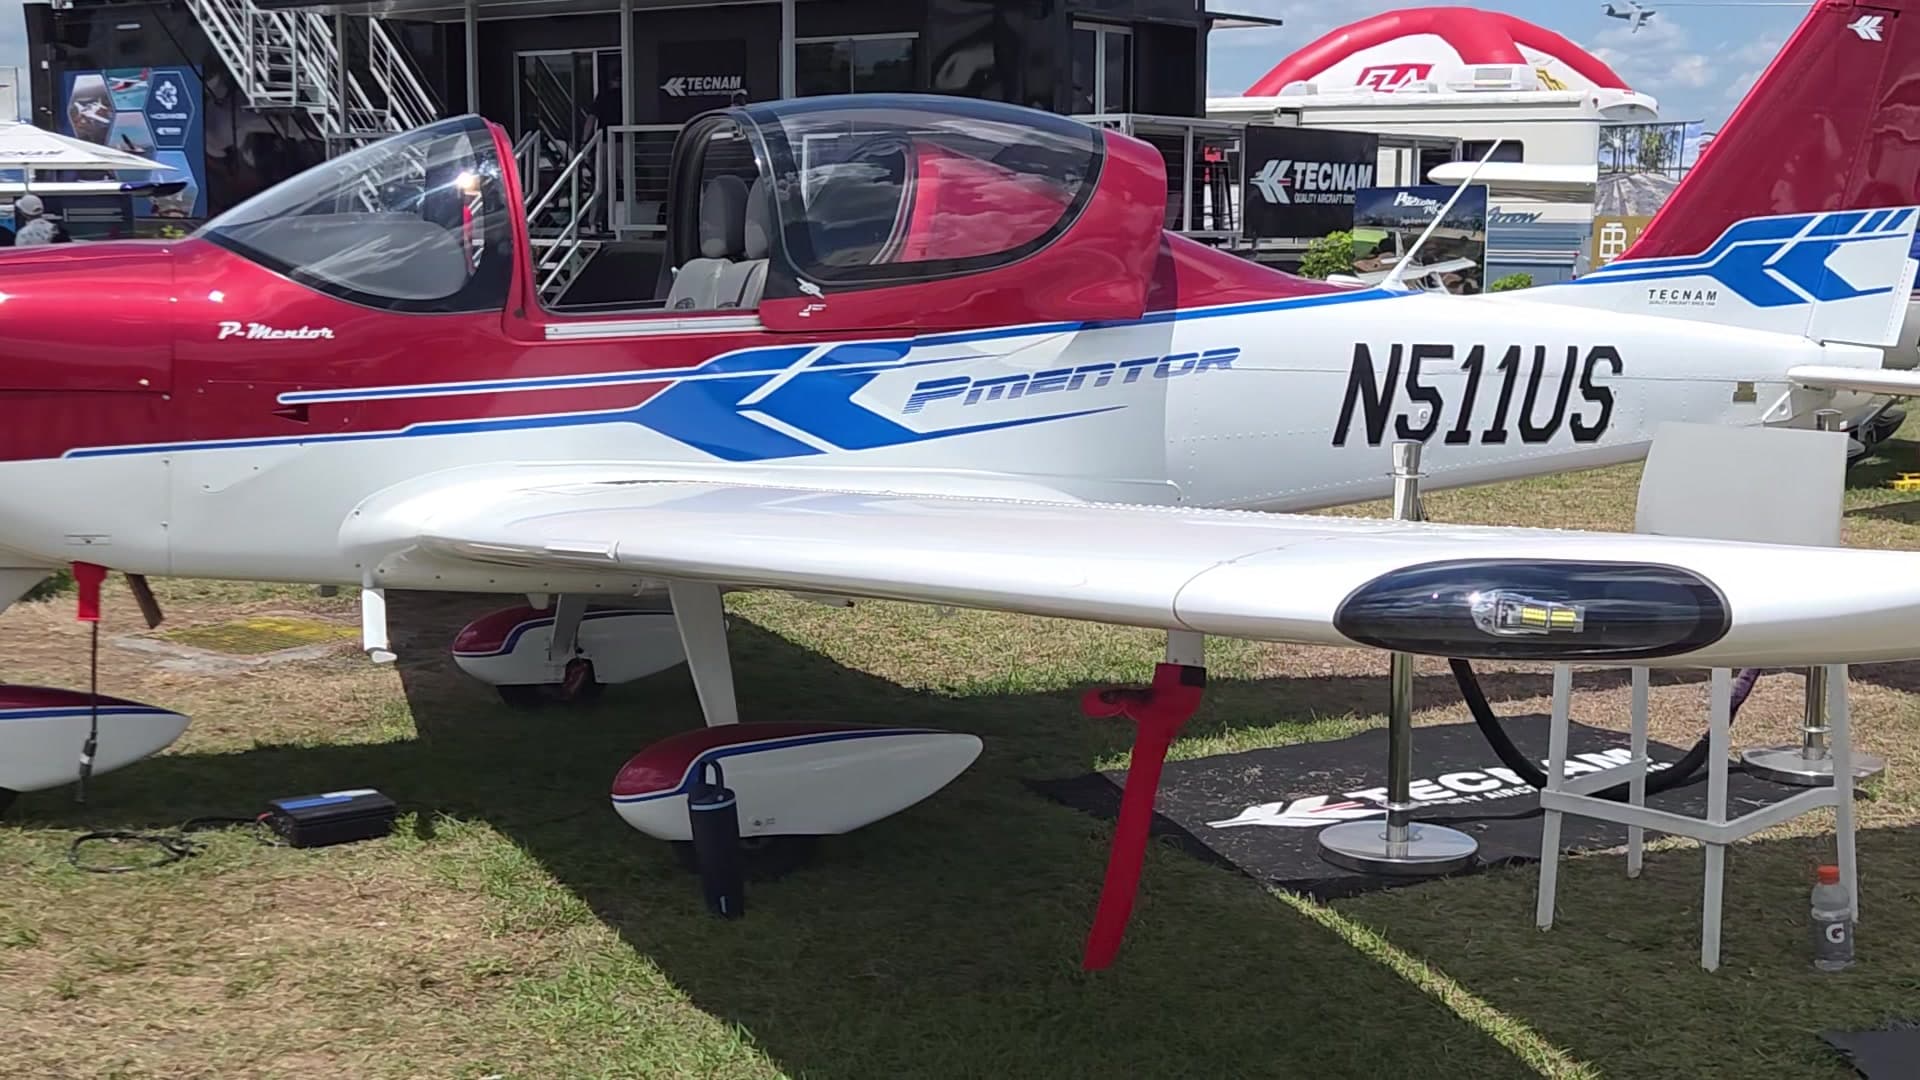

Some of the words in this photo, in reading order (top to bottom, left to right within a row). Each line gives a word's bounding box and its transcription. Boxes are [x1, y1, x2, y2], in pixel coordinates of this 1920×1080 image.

[687, 76, 741, 90] TECNAM
[1294, 161, 1373, 191] TECNAM
[1648, 289, 1718, 301] TECNAM
[218, 321, 335, 339] P-Mentor
[1332, 343, 1623, 447] N511US
[1826, 923, 1845, 943] G
